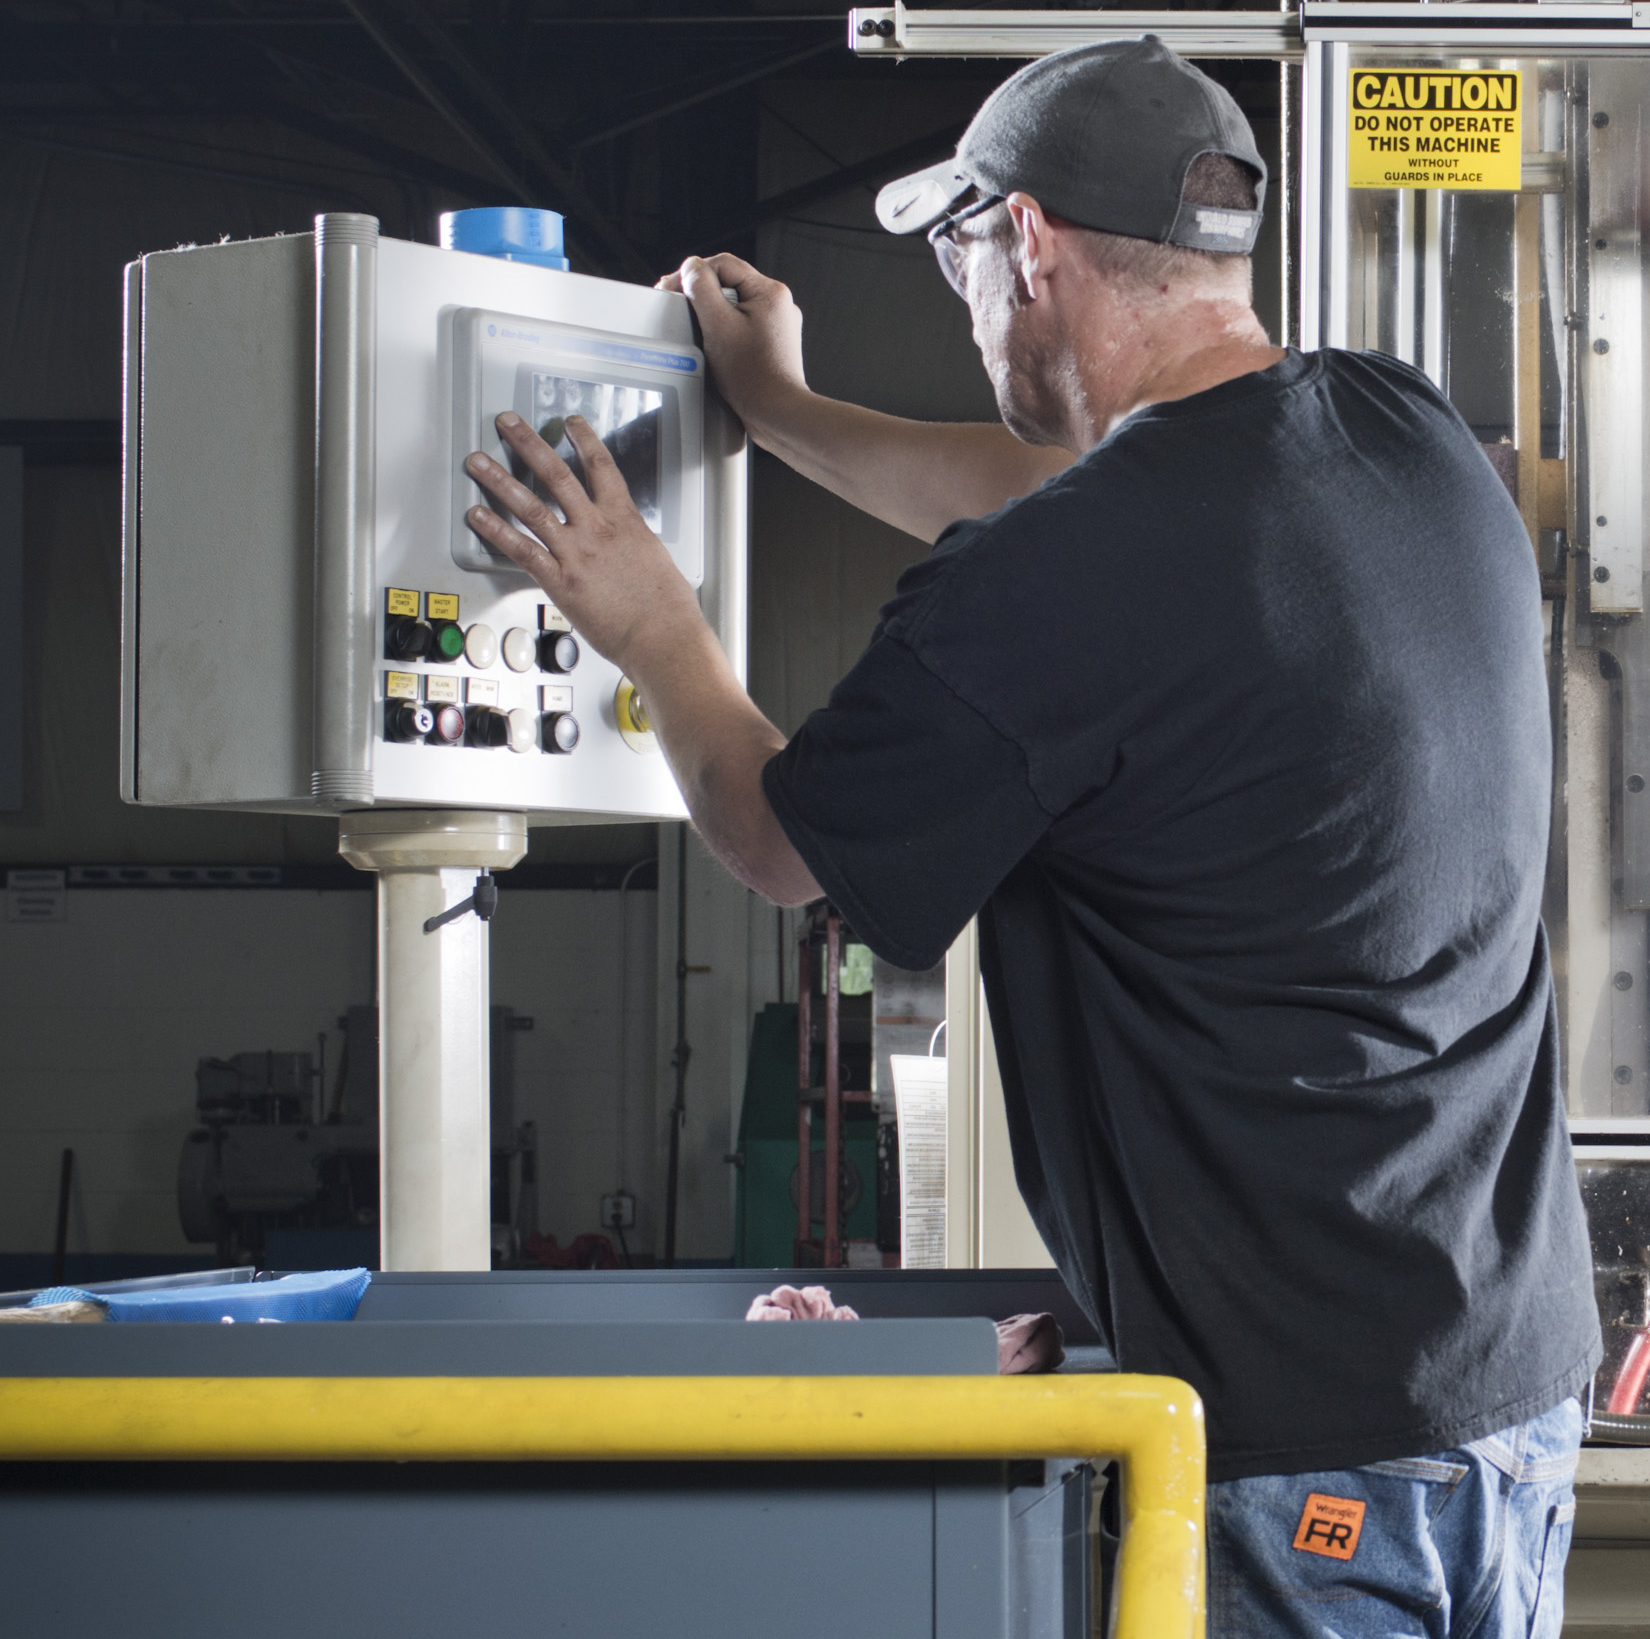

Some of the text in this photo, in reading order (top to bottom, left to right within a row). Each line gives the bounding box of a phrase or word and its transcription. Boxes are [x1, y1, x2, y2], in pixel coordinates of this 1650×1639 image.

[1356, 75, 1512, 109] CAUTION
[1355, 116, 1514, 133] DO NOT OPERATE
[1368, 136, 1501, 153] THIS MACHINE
[1408, 158, 1459, 168] WITHOUT
[1384, 172, 1483, 182] GUARDS IN PLACE
[1316, 1503, 1357, 1520] Wrangler
[1304, 1518, 1353, 1550] FR
